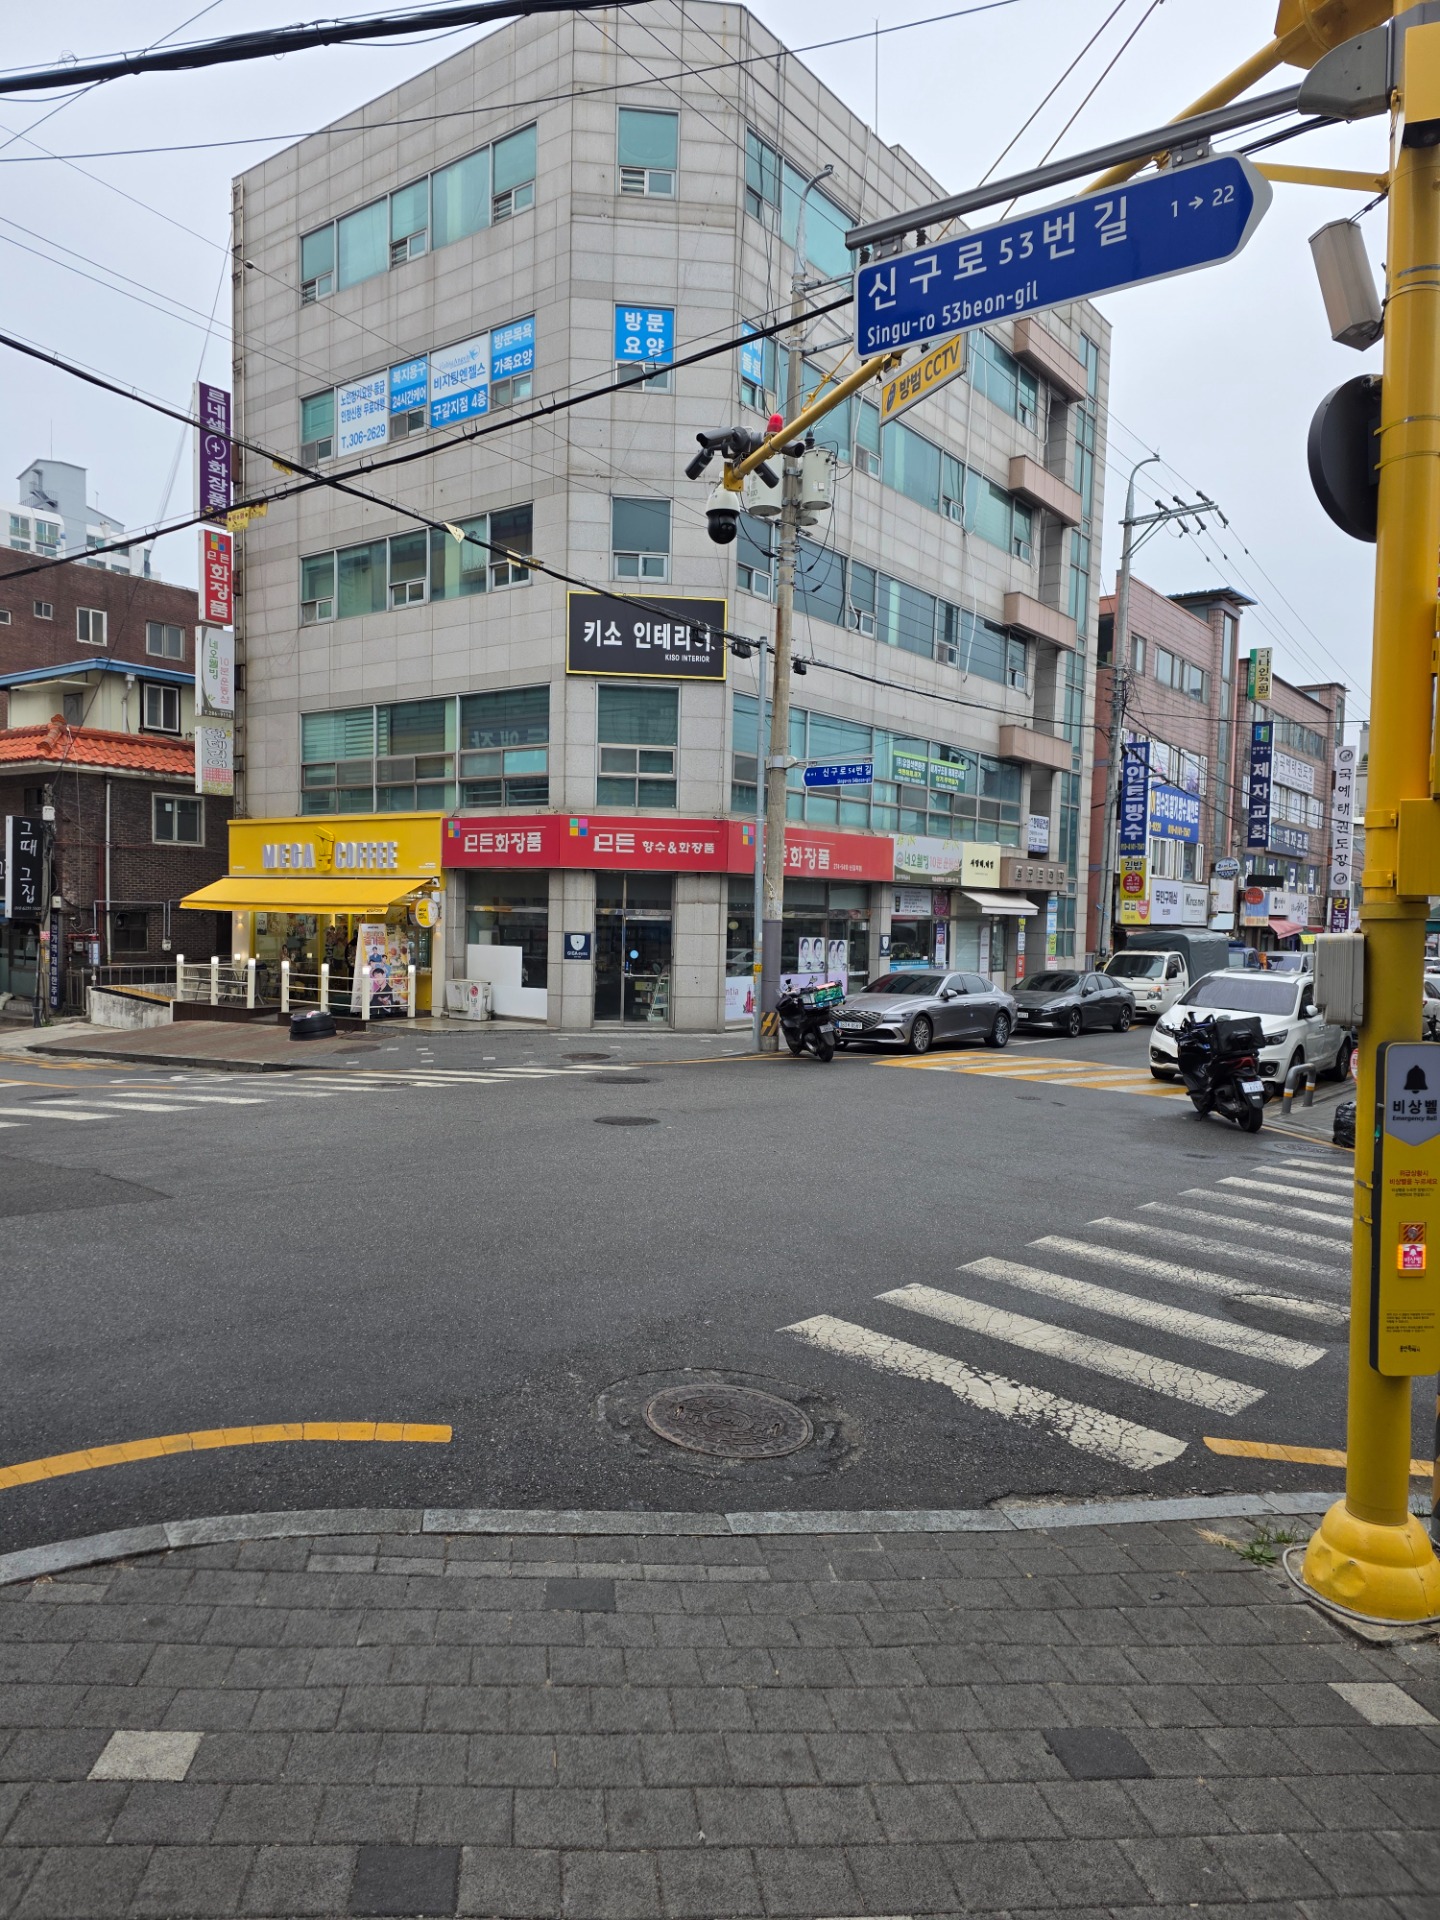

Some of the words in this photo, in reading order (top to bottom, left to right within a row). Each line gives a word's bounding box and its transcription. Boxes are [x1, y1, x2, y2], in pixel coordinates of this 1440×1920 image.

[1170, 200, 1180, 218] 1
[1212, 184, 1235, 208] 22
[867, 195, 1129, 311] 신구로53번길
[625, 312, 664, 333] 방문
[867, 312, 935, 348] Singu-ro
[942, 279, 1038, 323] 53beon-gil
[494, 323, 533, 349] 방문목욕
[624, 336, 664, 357] 요양
[393, 361, 426, 384] 복지용구
[494, 349, 533, 374] 가족요양
[899, 367, 921, 400] 방범
[924, 340, 960, 382] CCTV
[433, 362, 486, 390] 비지팅엔젤스
[433, 396, 469, 421] 구갈지점
[341, 423, 386, 449] T.306-2629
[207, 459, 229, 511] 화장품
[209, 563, 229, 619] 화장품
[583, 619, 622, 647] 키소
[633, 622, 711, 652] 인테리어
[665, 653, 680, 662] KISO
[682, 654, 710, 663] INTERIOR
[1124, 746, 1146, 841] 페인트방수
[1250, 761, 1269, 840] 제자교회
[20, 821, 38, 857] 그때
[642, 840, 715, 854] 향수&화장품
[262, 843, 316, 869] MEGA
[335, 842, 398, 869] COFFEE
[1124, 861, 1143, 870] 김밥
[20, 867, 36, 904] 그집
[1393, 1099, 1438, 1115] 비상벨
